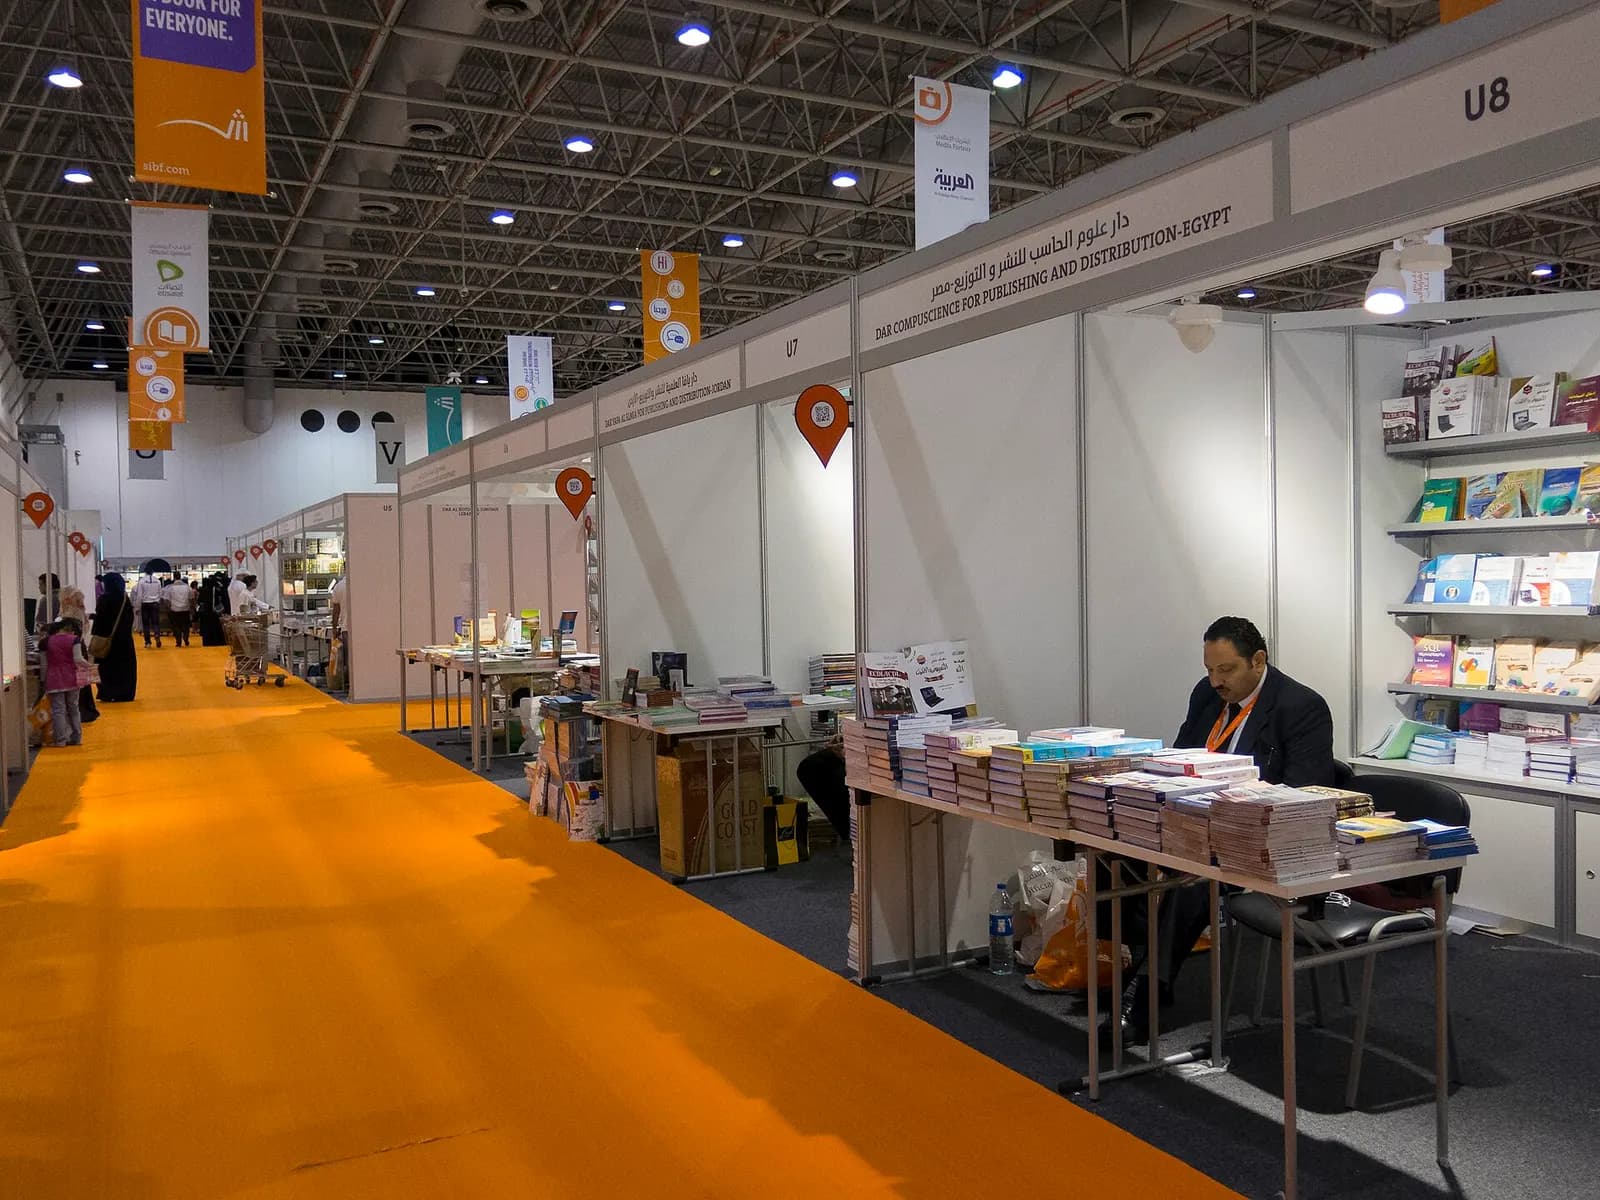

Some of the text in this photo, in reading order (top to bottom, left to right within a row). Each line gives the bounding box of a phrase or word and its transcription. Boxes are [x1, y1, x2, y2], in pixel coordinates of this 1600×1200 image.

[145, 7, 233, 41] EVERYONE.
[1465, 76, 1510, 121] U8
[143, 162, 190, 176] sibf.com
[933, 167, 974, 191] العربية
[1076, 219, 1108, 250] علوم
[1110, 211, 1130, 239] دار
[1029, 229, 1073, 265] الحاسب
[875, 205, 1232, 340] DAR COMPUSCIENCE FOR PUBLISHING AND DISTRIBUTION-EGYPT
[988, 264, 996, 282] و
[998, 247, 1027, 279] للنشر
[786, 338, 799, 358] U7
[379, 441, 402, 465] V
[717, 817, 758, 839] COST
